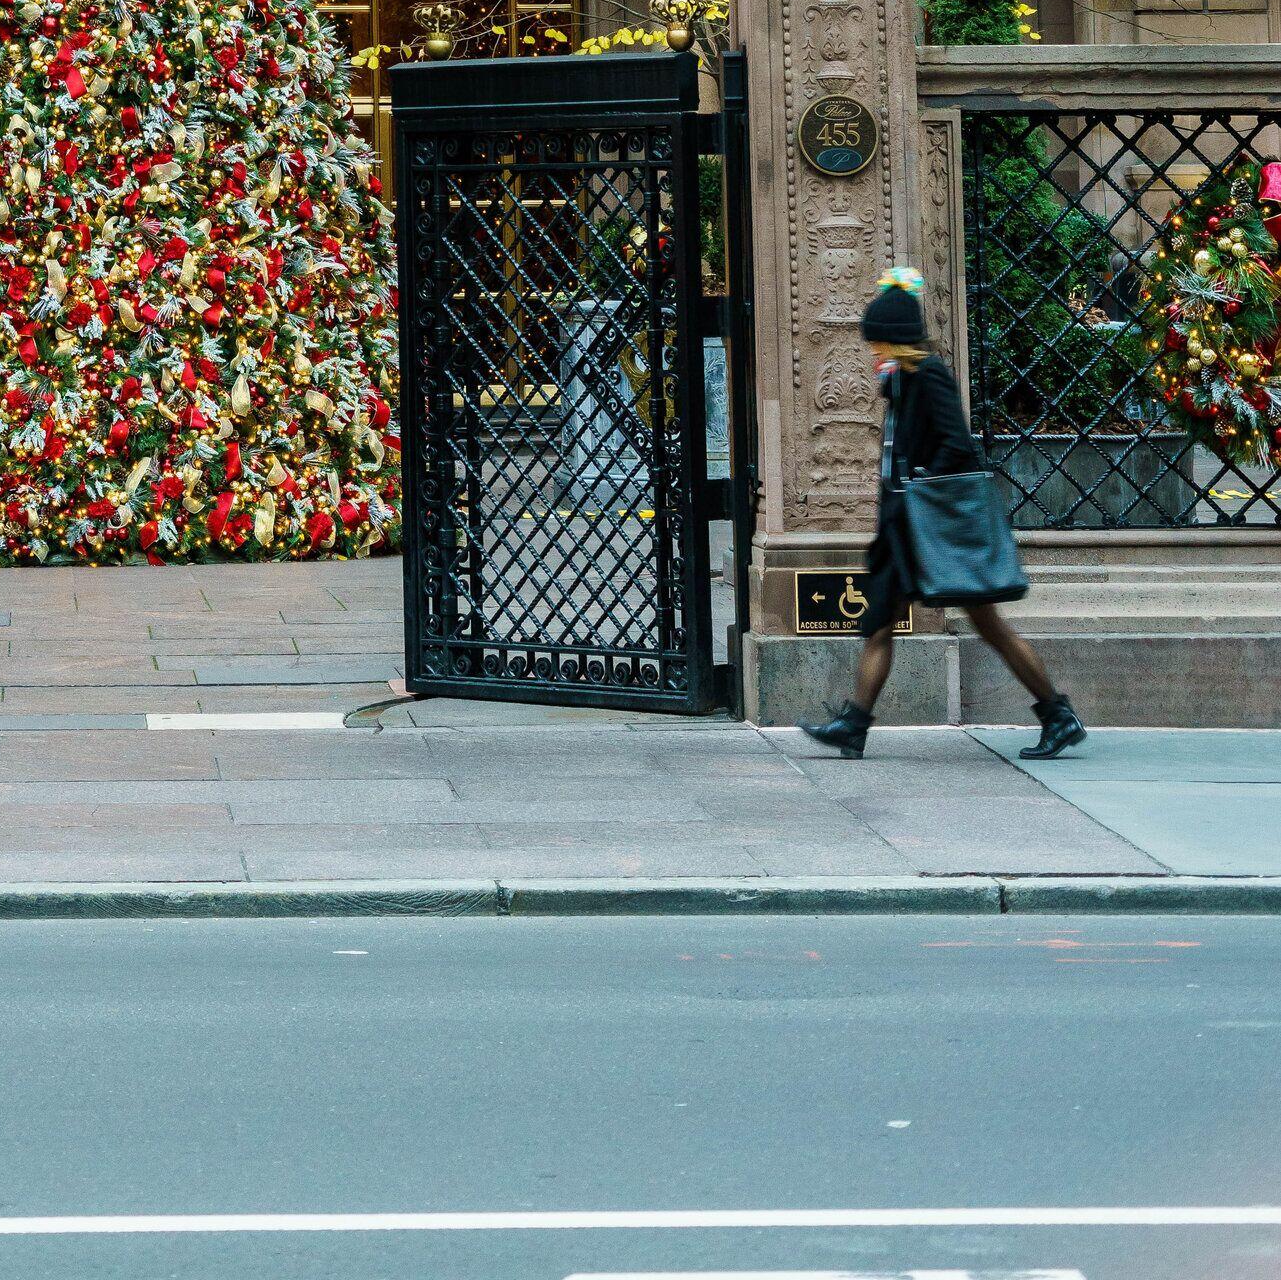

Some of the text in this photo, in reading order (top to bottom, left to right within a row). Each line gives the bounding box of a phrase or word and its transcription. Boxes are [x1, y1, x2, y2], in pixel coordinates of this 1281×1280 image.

[816, 122, 861, 146] 455
[800, 621, 827, 629] ACCESS
[830, 621, 840, 629] ON
[842, 620, 858, 629] 50TH
